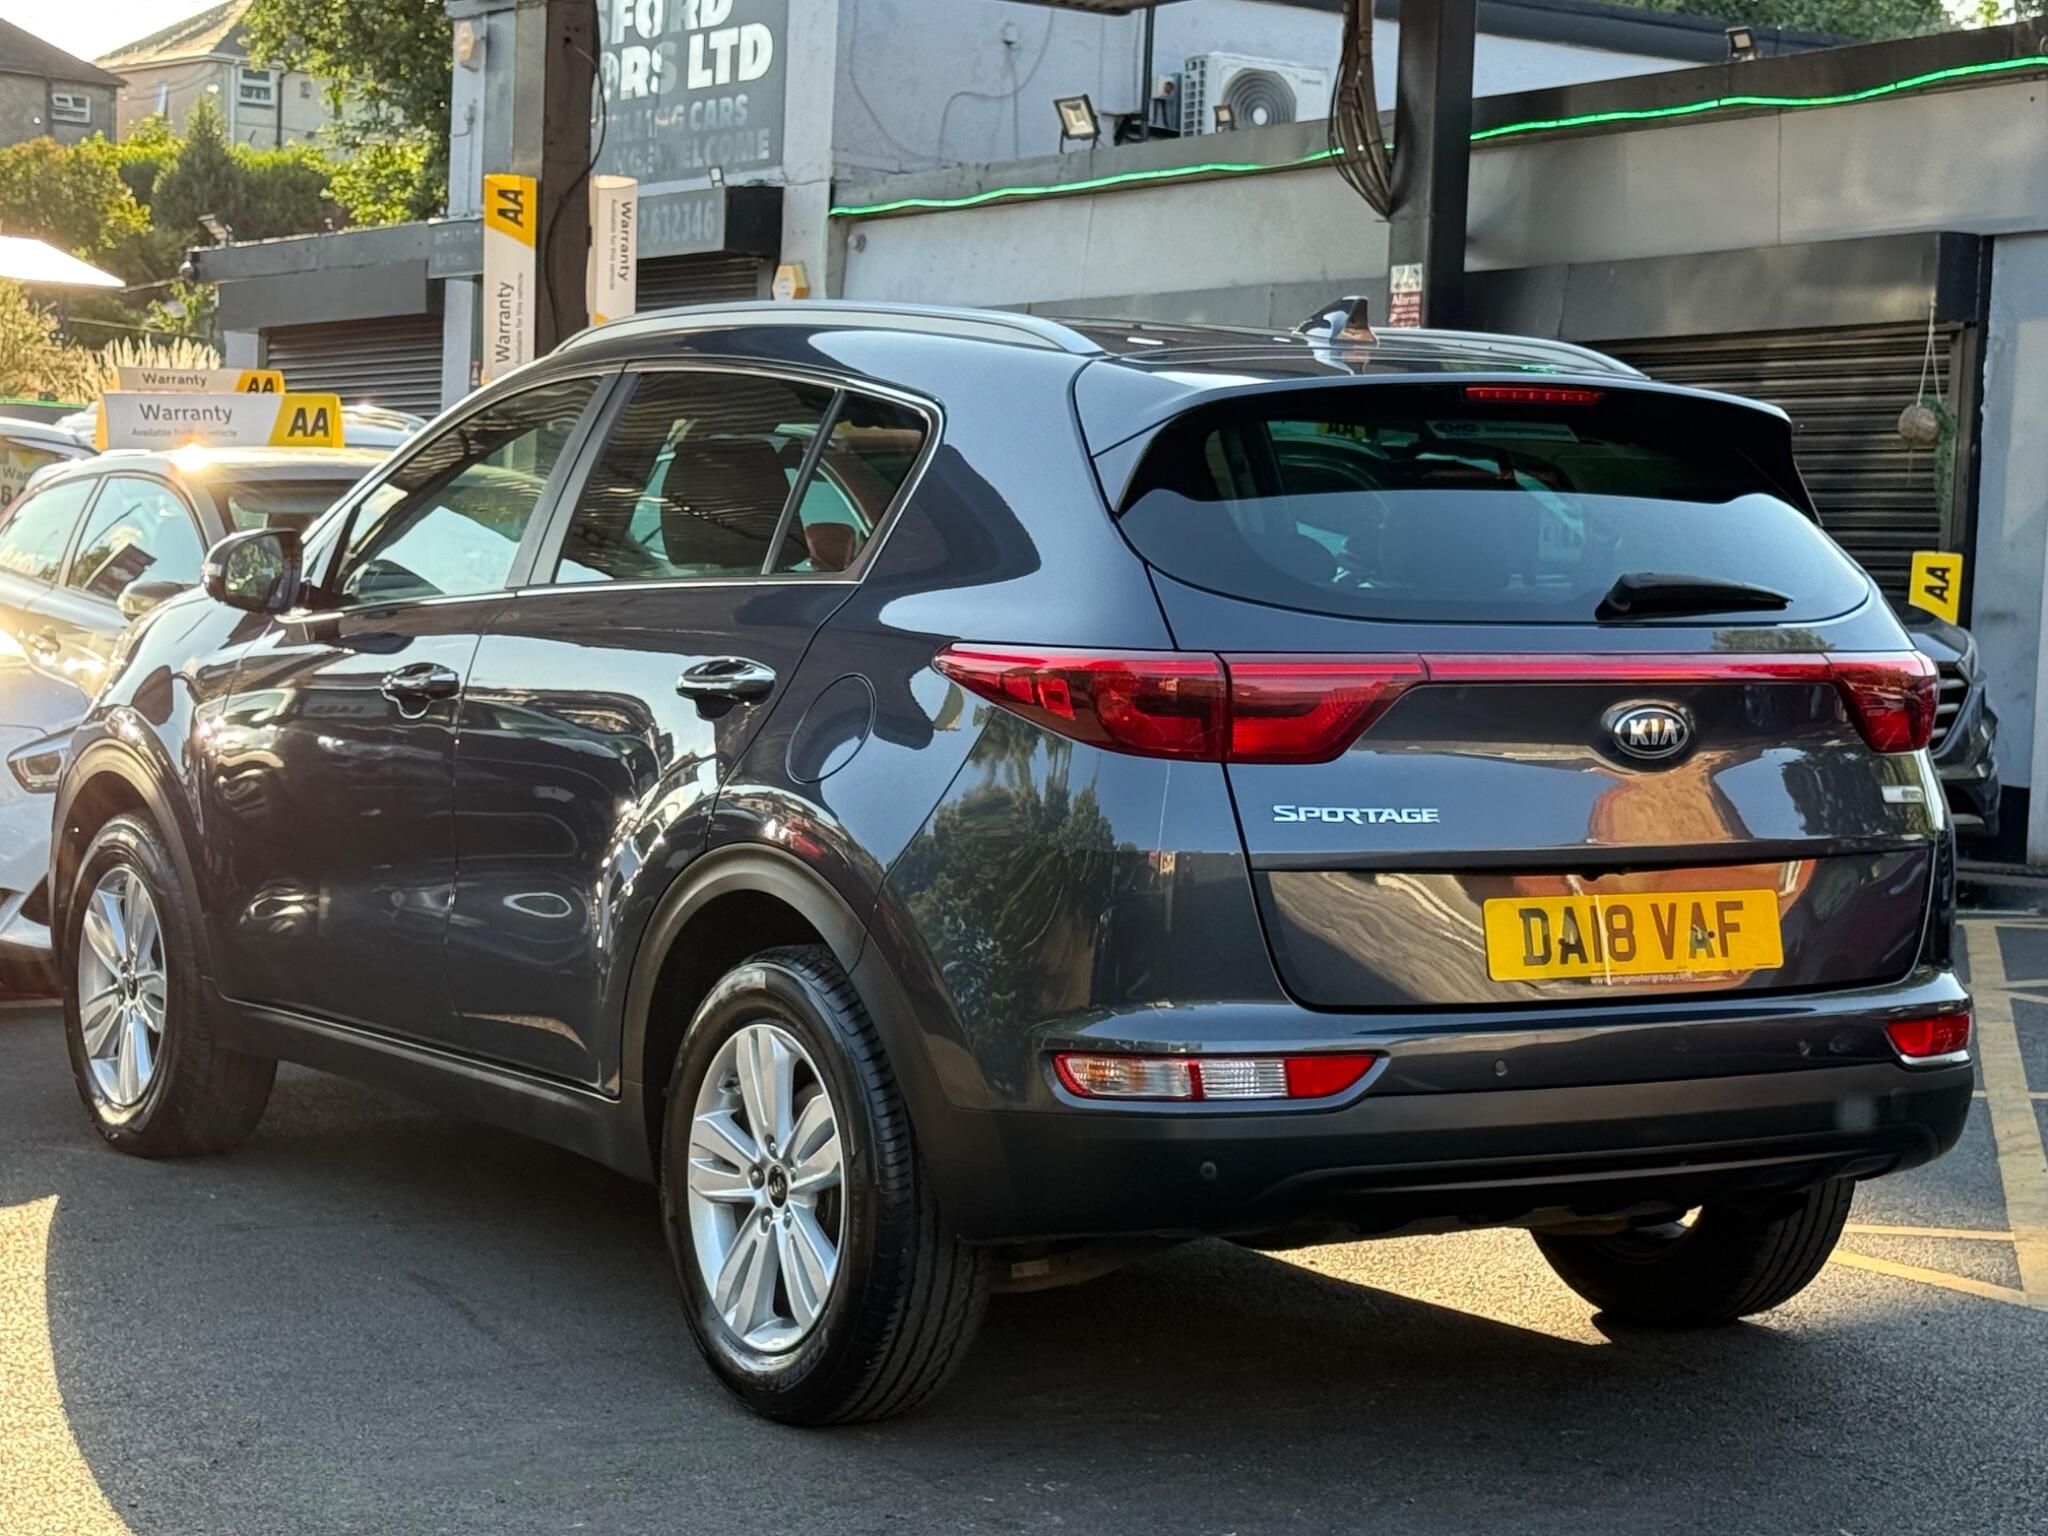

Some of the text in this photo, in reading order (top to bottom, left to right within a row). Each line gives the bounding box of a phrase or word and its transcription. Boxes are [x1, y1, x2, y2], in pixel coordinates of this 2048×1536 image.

[687, 22, 774, 90] LTD
[689, 93, 748, 132] CARS
[497, 190, 524, 228] AA
[617, 201, 633, 281] Warranty
[495, 282, 514, 363] Warranty
[142, 373, 275, 393] Warranty AA
[140, 404, 329, 437] Warranty AA
[1924, 566, 1951, 604] AA
[1628, 718, 1678, 746] KIA
[1273, 805, 1440, 824] SPORTAGE
[1518, 900, 1744, 966] DA18 VAF
